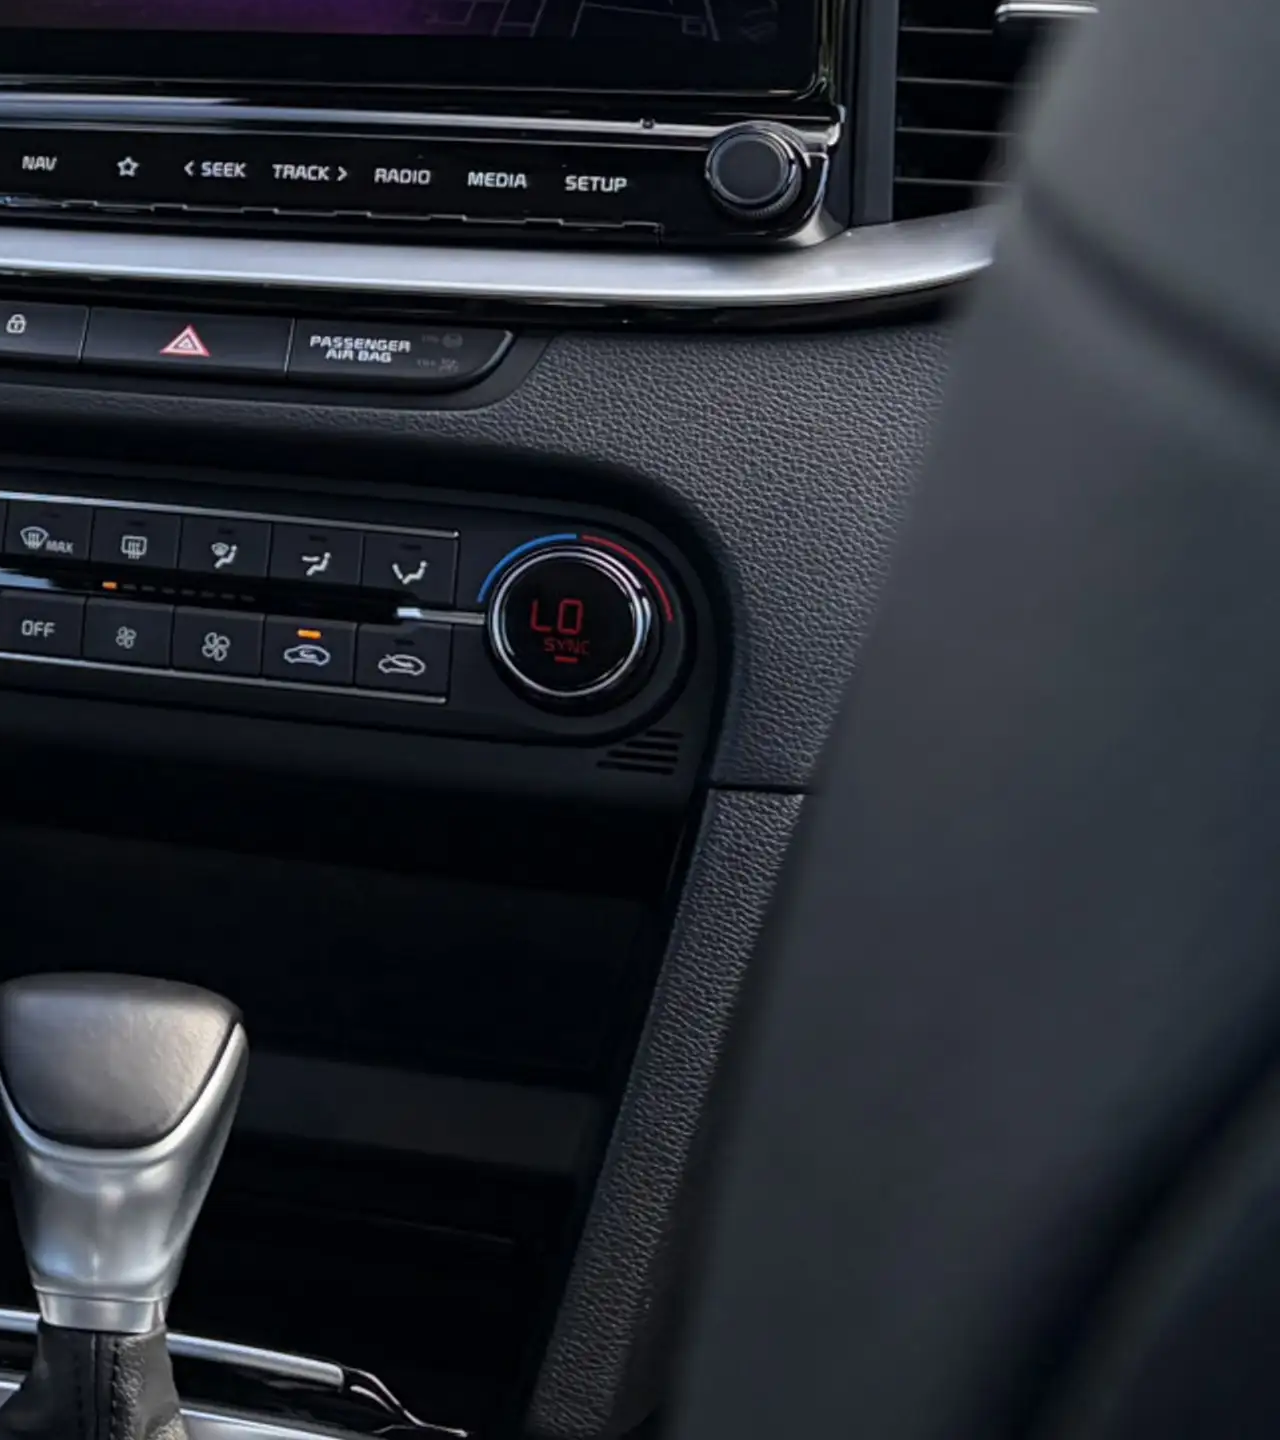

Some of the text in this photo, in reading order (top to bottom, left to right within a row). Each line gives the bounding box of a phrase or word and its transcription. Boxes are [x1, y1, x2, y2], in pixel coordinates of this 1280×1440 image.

[21, 156, 58, 171] NAV
[200, 162, 247, 178] SEEK
[272, 163, 331, 181] TRACK
[374, 167, 432, 185] RADIO
[467, 171, 529, 189] MEDIA
[564, 174, 629, 192] SETUP
[309, 334, 412, 354] PASSENGER
[324, 348, 393, 364] AIR BAG
[45, 540, 75, 553] MAX
[529, 598, 585, 636] LO
[20, 620, 56, 637] OFF
[543, 637, 591, 655] SYNC
